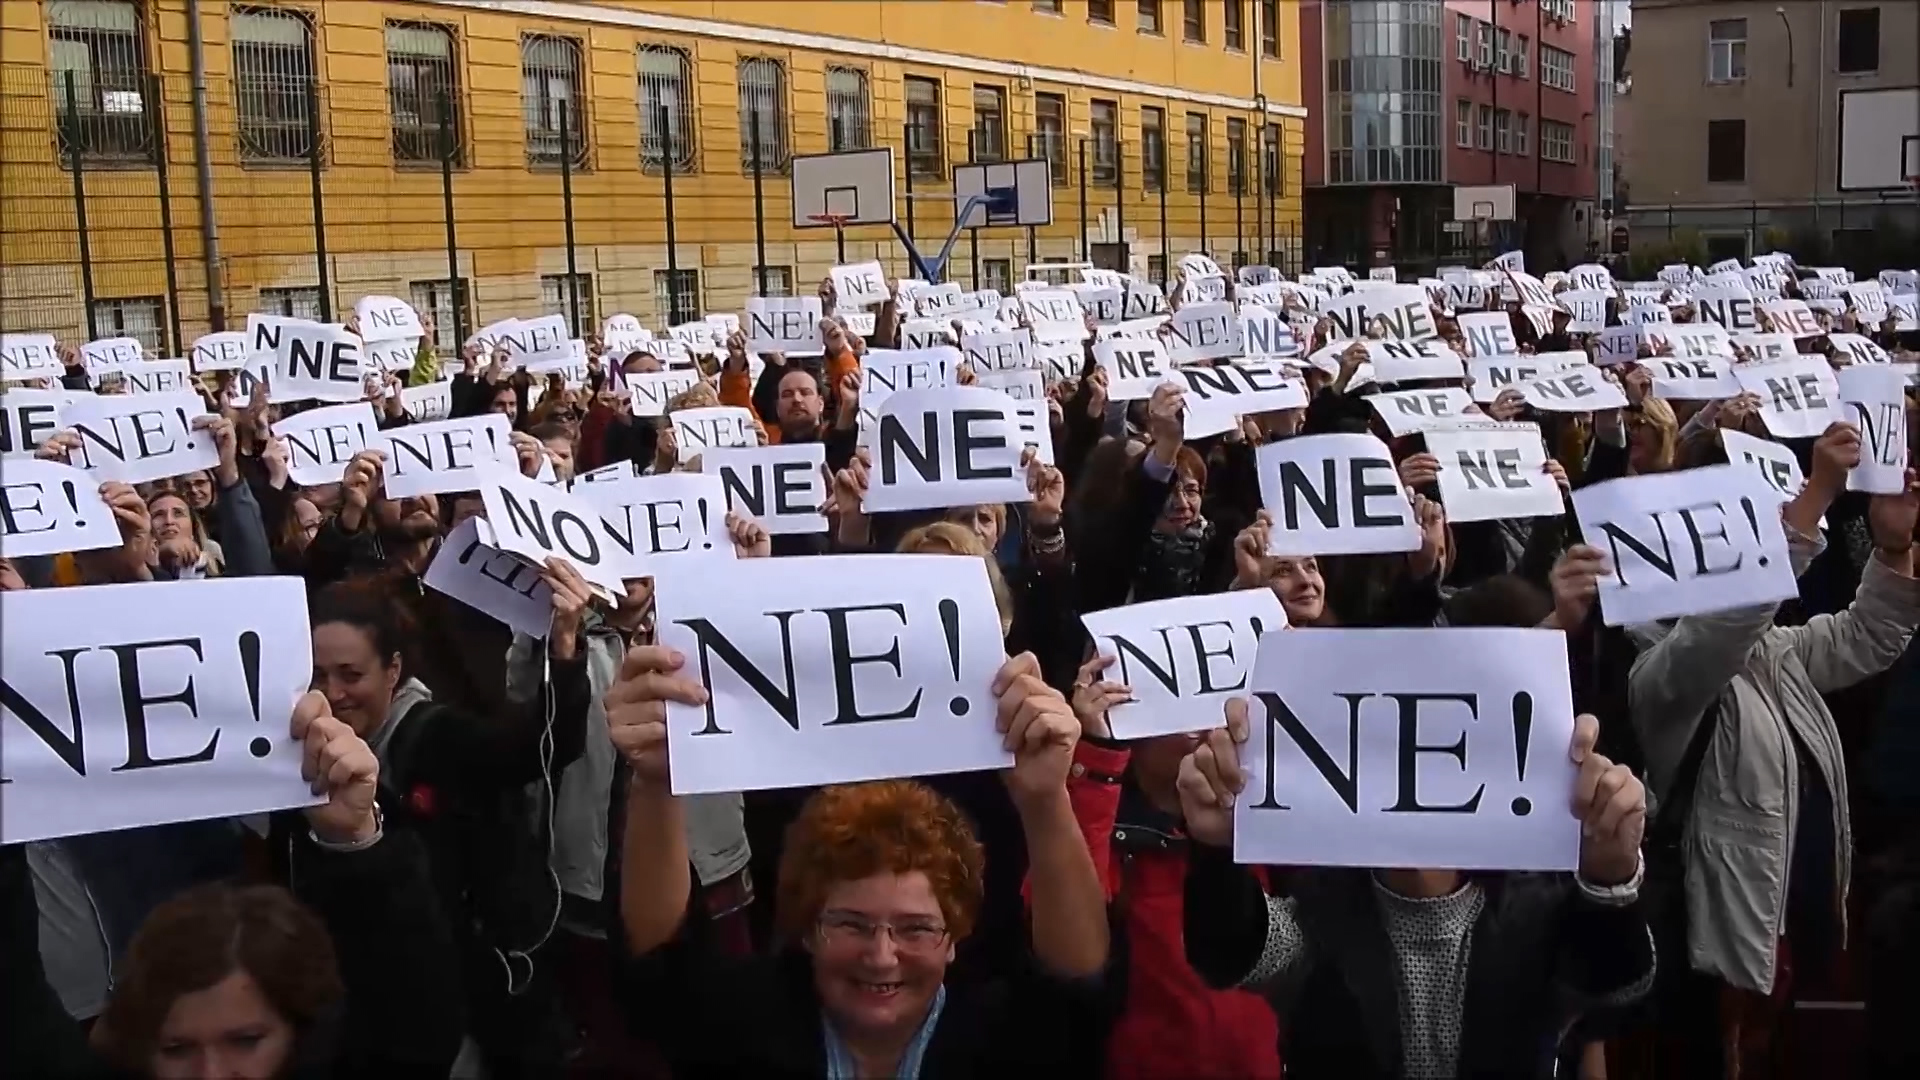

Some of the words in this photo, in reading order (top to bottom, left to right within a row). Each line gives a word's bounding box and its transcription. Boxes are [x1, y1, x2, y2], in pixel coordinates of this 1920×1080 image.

[844, 273, 880, 296] NE
[1580, 273, 1605, 290] NE
[1750, 273, 1776, 291] NE
[370, 307, 408, 327] NE
[928, 294, 954, 310] NE
[1566, 299, 1600, 322] NE!
[1700, 299, 1757, 330] NE
[751, 311, 813, 340] NE!
[853, 317, 874, 330] NE
[1168, 315, 1230, 349] NE!
[1248, 318, 1298, 354] NE
[1376, 301, 1432, 340] NE
[1772, 309, 1821, 334] NE
[198, 340, 246, 363] NE!
[501, 325, 560, 356] NE!
[647, 341, 680, 358] NE
[679, 329, 706, 346] NE
[1383, 342, 1440, 358] NE
[1467, 325, 1509, 357] NE
[1598, 334, 1640, 357] NE!
[1681, 334, 1722, 357] NE
[1848, 341, 1885, 364] NE
[88, 345, 140, 367] NE!
[289, 339, 359, 382] NE
[969, 342, 1026, 372] NE!
[1114, 350, 1162, 379] NE
[1662, 360, 1718, 380] NE
[129, 371, 183, 393] NE!
[867, 361, 946, 394] NE!
[1181, 363, 1288, 399] NE
[1532, 374, 1596, 399] NE
[1764, 374, 1829, 412] NE
[1395, 394, 1454, 417] NE
[70, 407, 196, 469] NE!
[285, 421, 369, 467] NE!
[676, 416, 744, 447] NE!
[388, 423, 500, 477] NE!
[880, 410, 1014, 486] NE
[1456, 448, 1531, 490] NE
[720, 461, 820, 516] NE
[1280, 458, 1404, 530] NE
[0, 480, 86, 534] E!
[499, 485, 600, 566] NO
[1589, 496, 1770, 588] NE!
[673, 598, 972, 737] NE!
[0, 631, 273, 784] NE!
[1249, 691, 1535, 817] NE!
